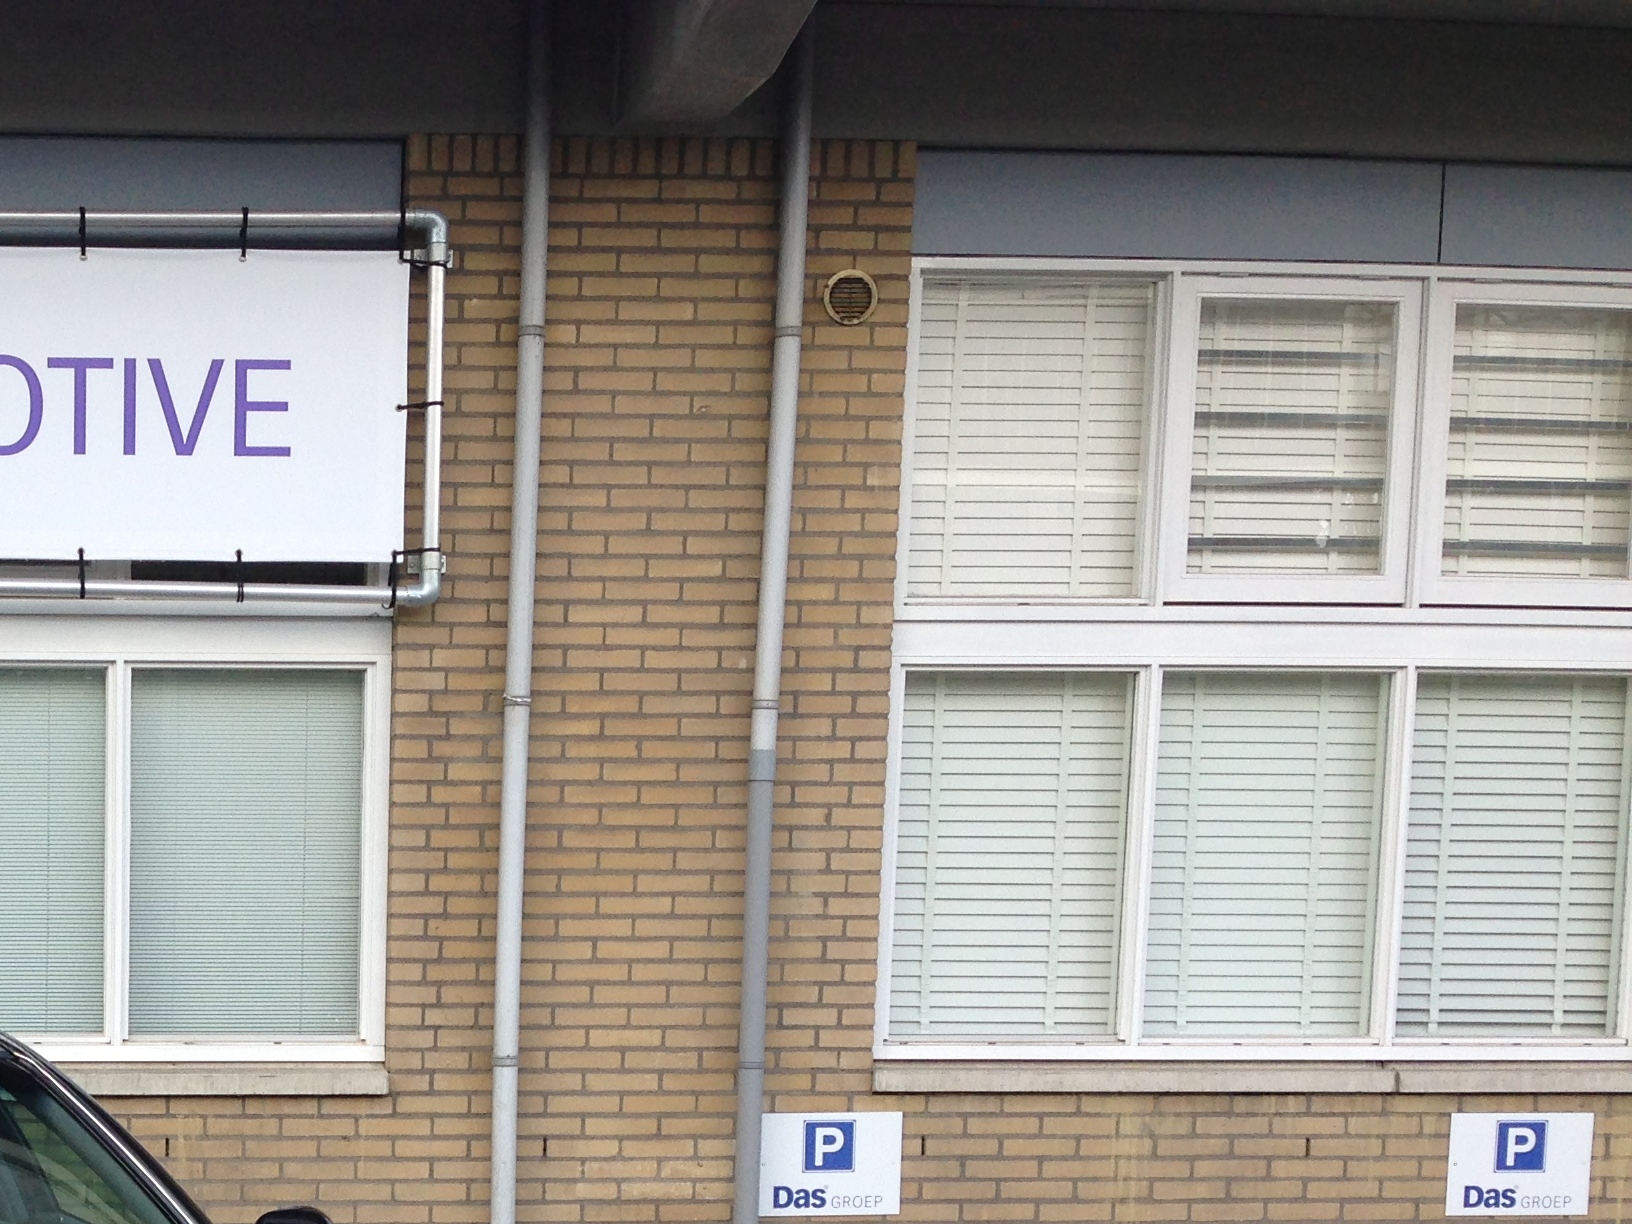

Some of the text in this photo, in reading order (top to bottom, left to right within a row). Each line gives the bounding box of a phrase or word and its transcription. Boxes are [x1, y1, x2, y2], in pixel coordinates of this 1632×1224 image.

[814, 1127, 845, 1167] P
[1506, 1127, 1537, 1167] P
[772, 1185, 883, 1209] Das GROEP
[1463, 1185, 1572, 1209] Das GROEP
